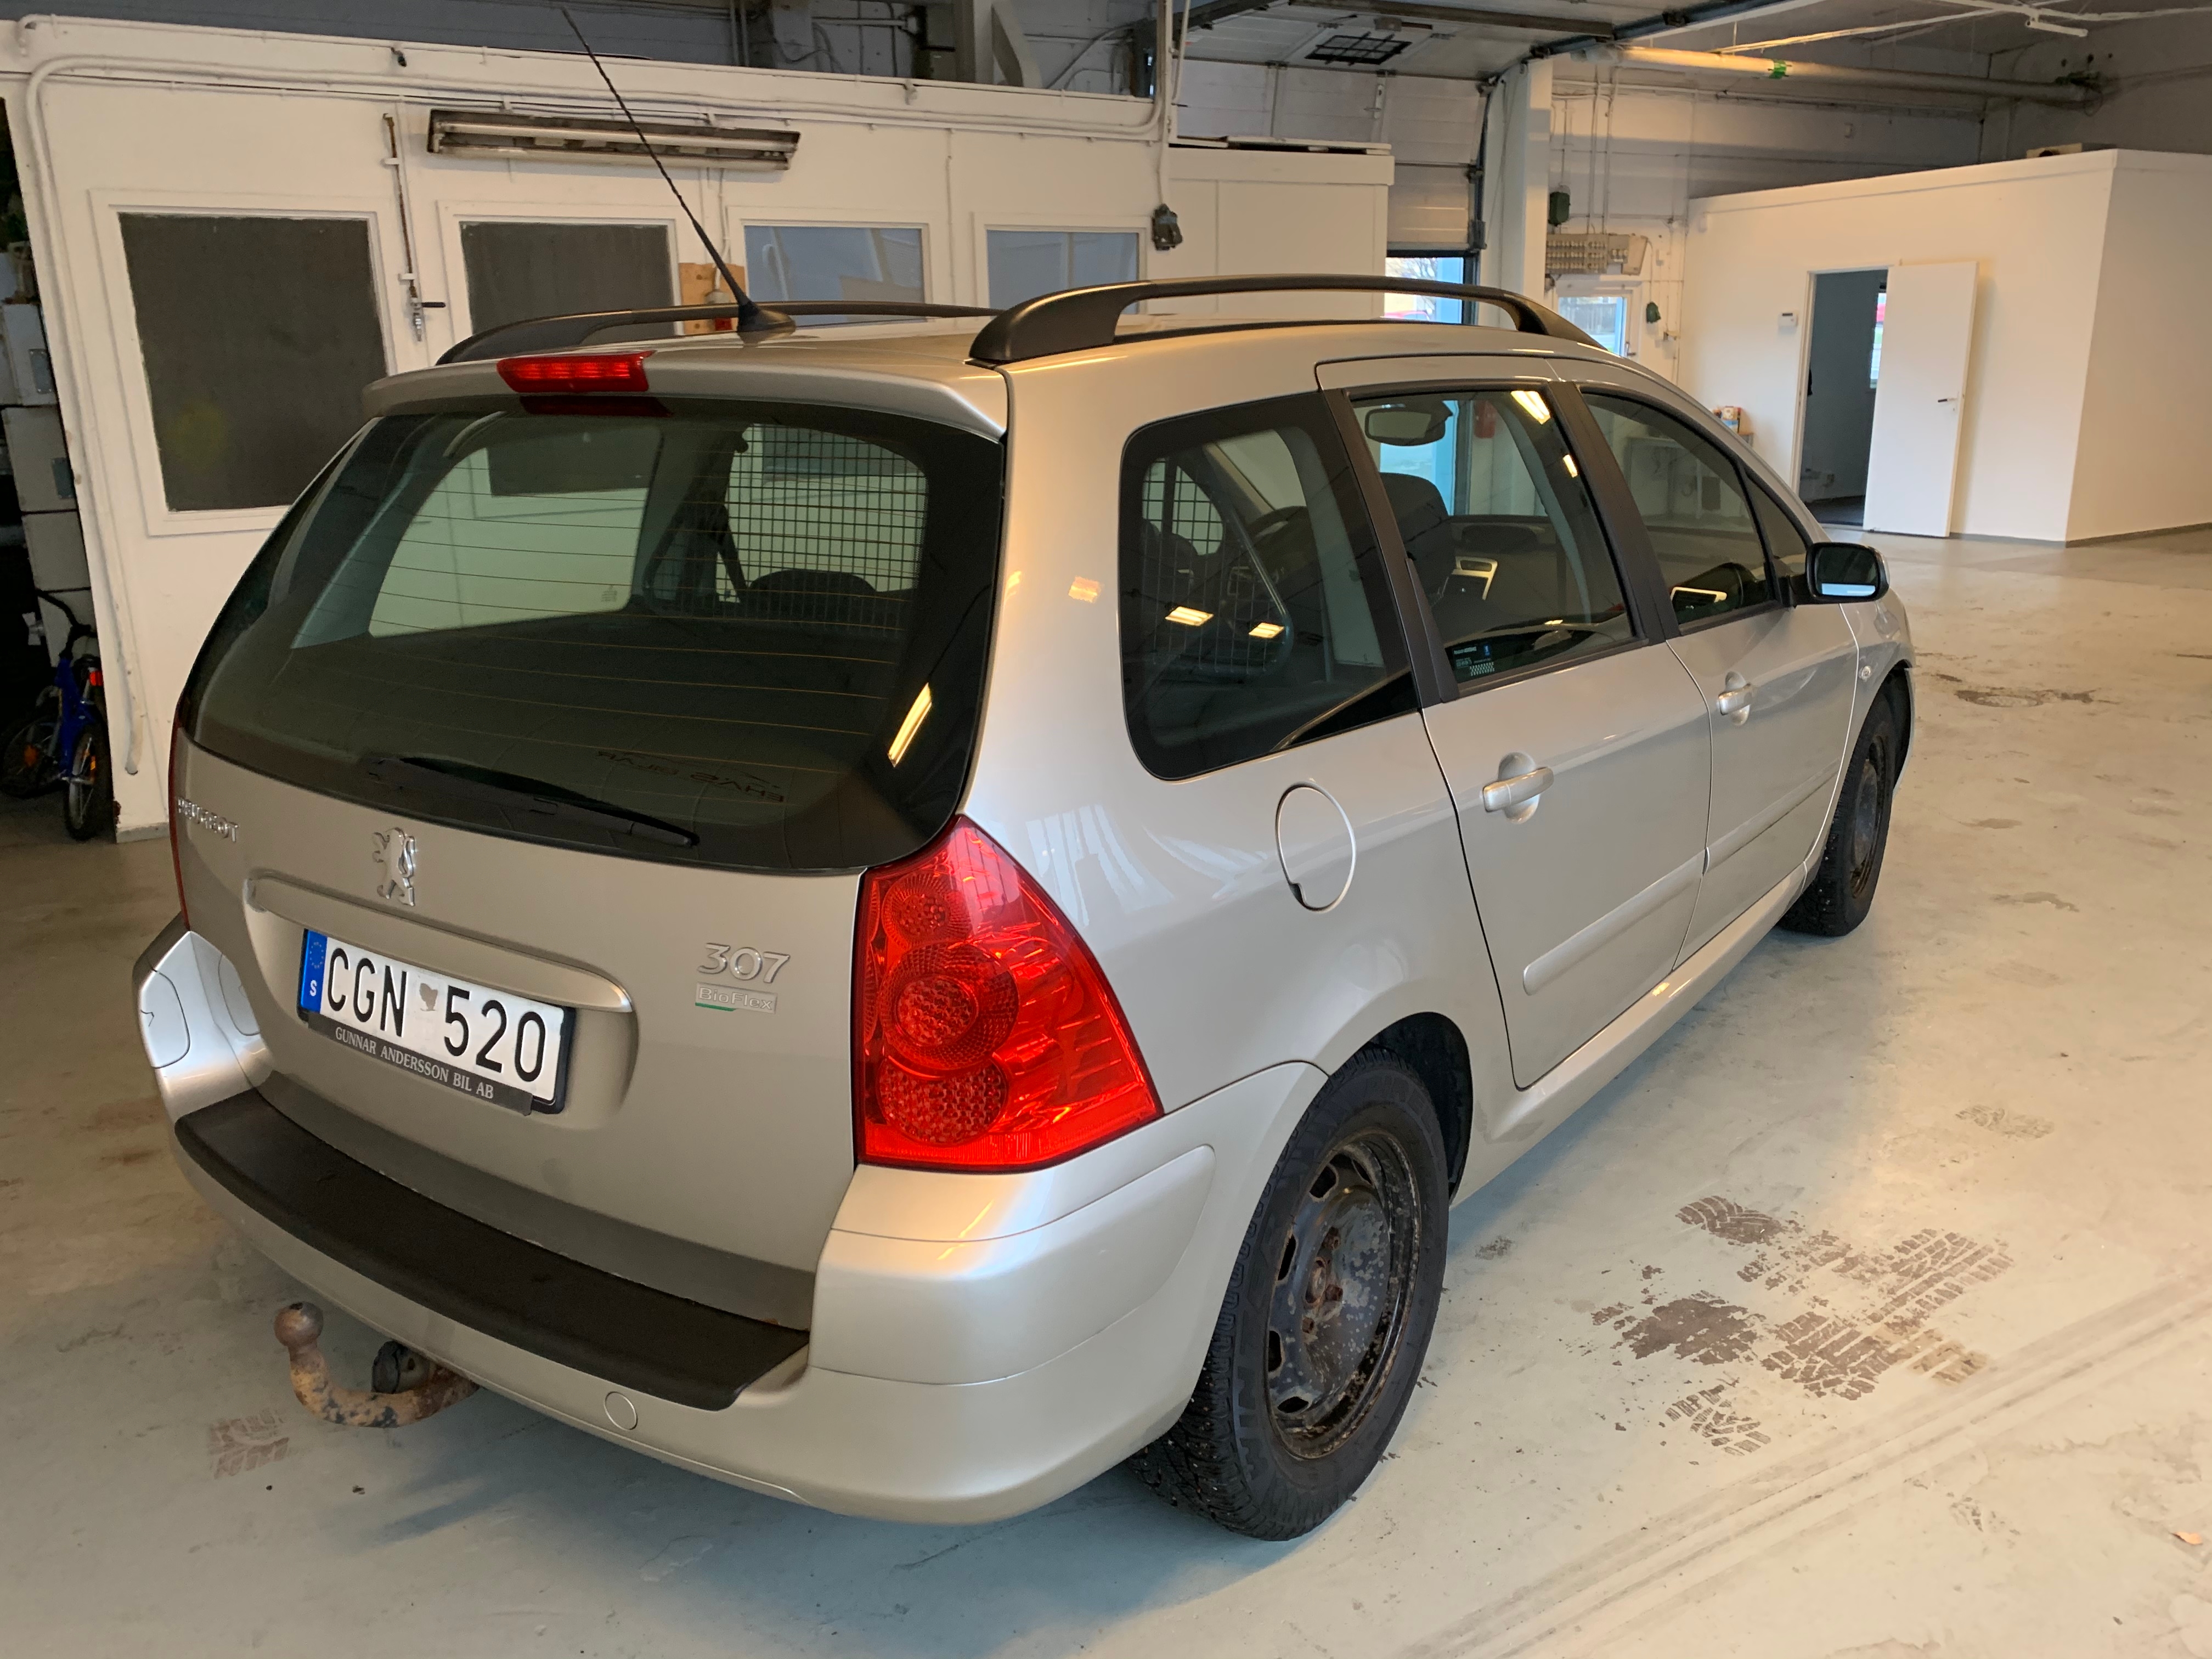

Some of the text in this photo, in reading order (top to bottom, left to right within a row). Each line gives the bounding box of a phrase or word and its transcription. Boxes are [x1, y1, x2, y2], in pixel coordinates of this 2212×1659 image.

[177, 798, 238, 842] PEUGEOT
[697, 942, 791, 984] 307
[309, 979, 318, 997] S
[698, 987, 773, 1010] BioFlex
[328, 947, 546, 1082] CGN 520
[335, 1026, 494, 1099] GUNNAR ANDERSSON BIL AB
